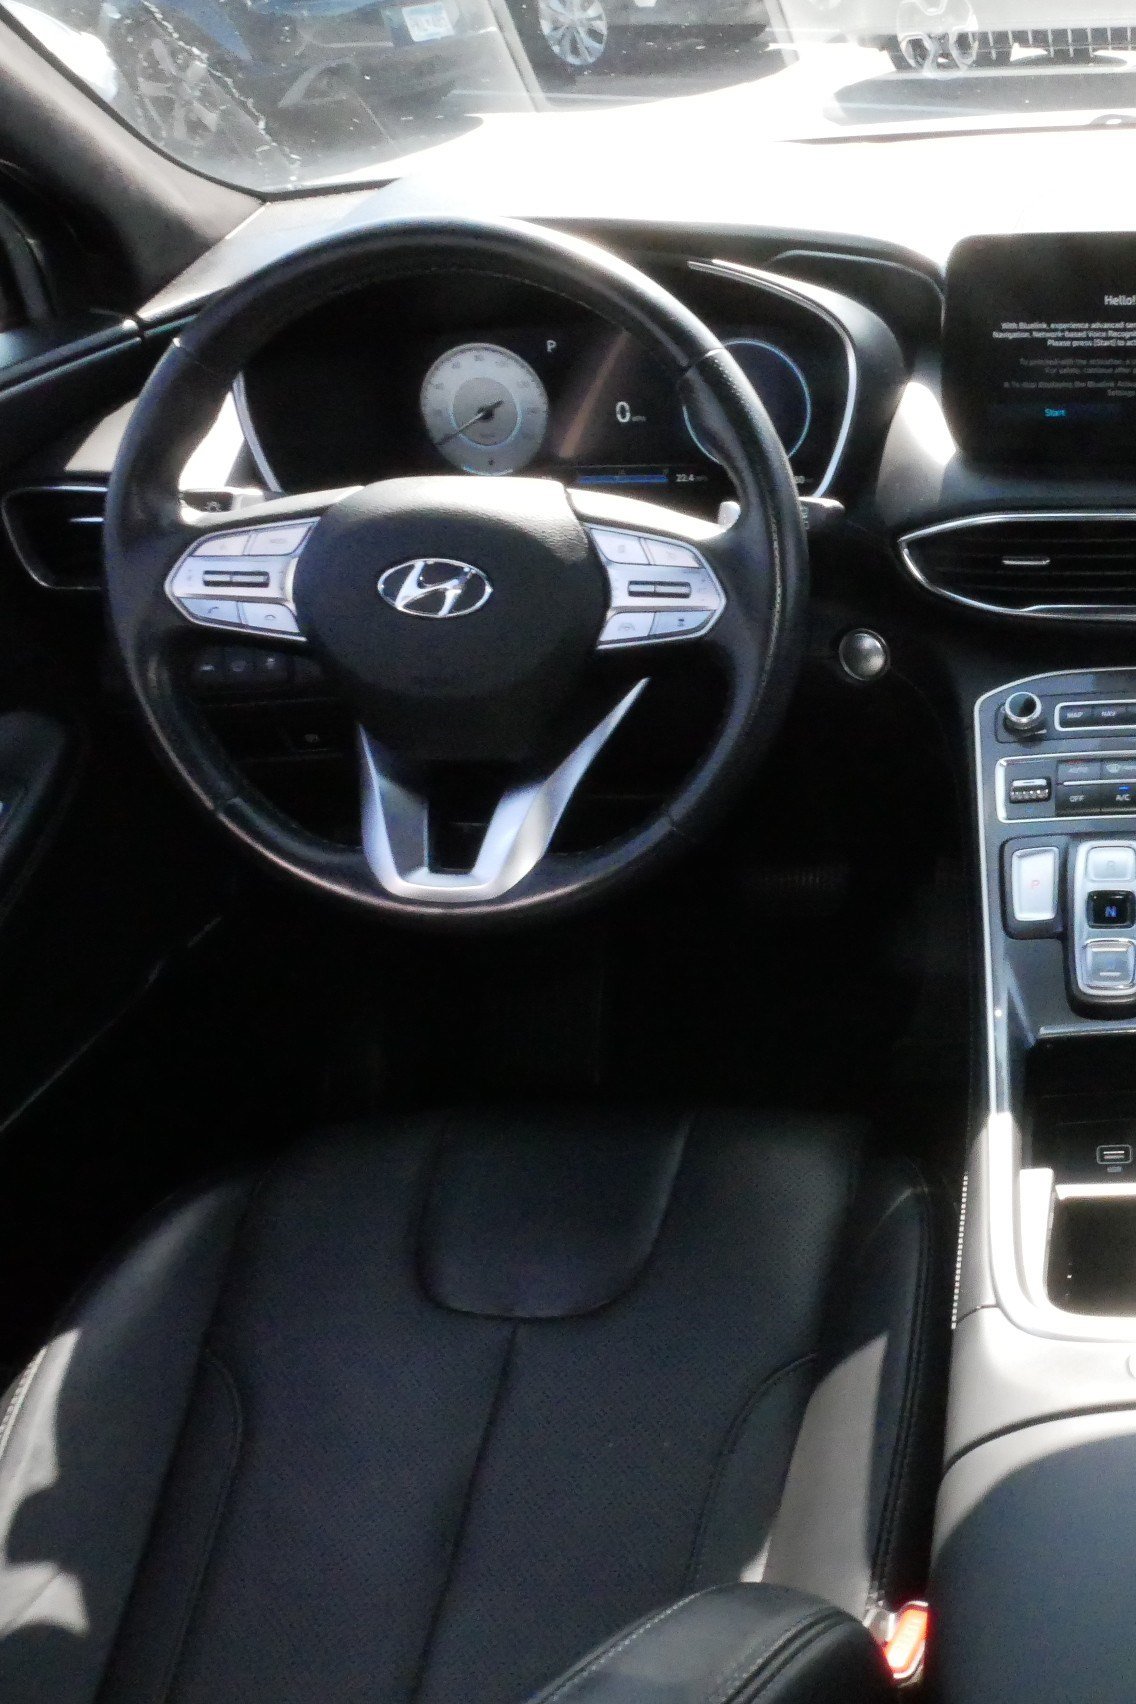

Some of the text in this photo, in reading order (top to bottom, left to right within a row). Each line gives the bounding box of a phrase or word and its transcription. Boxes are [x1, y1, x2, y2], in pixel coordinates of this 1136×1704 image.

[1104, 294, 1136, 306] Hello!
[547, 340, 557, 352] P
[1047, 339, 1071, 347] Please
[615, 400, 631, 424] 0
[1045, 408, 1065, 417] Start
[1105, 906, 1117, 918] N
